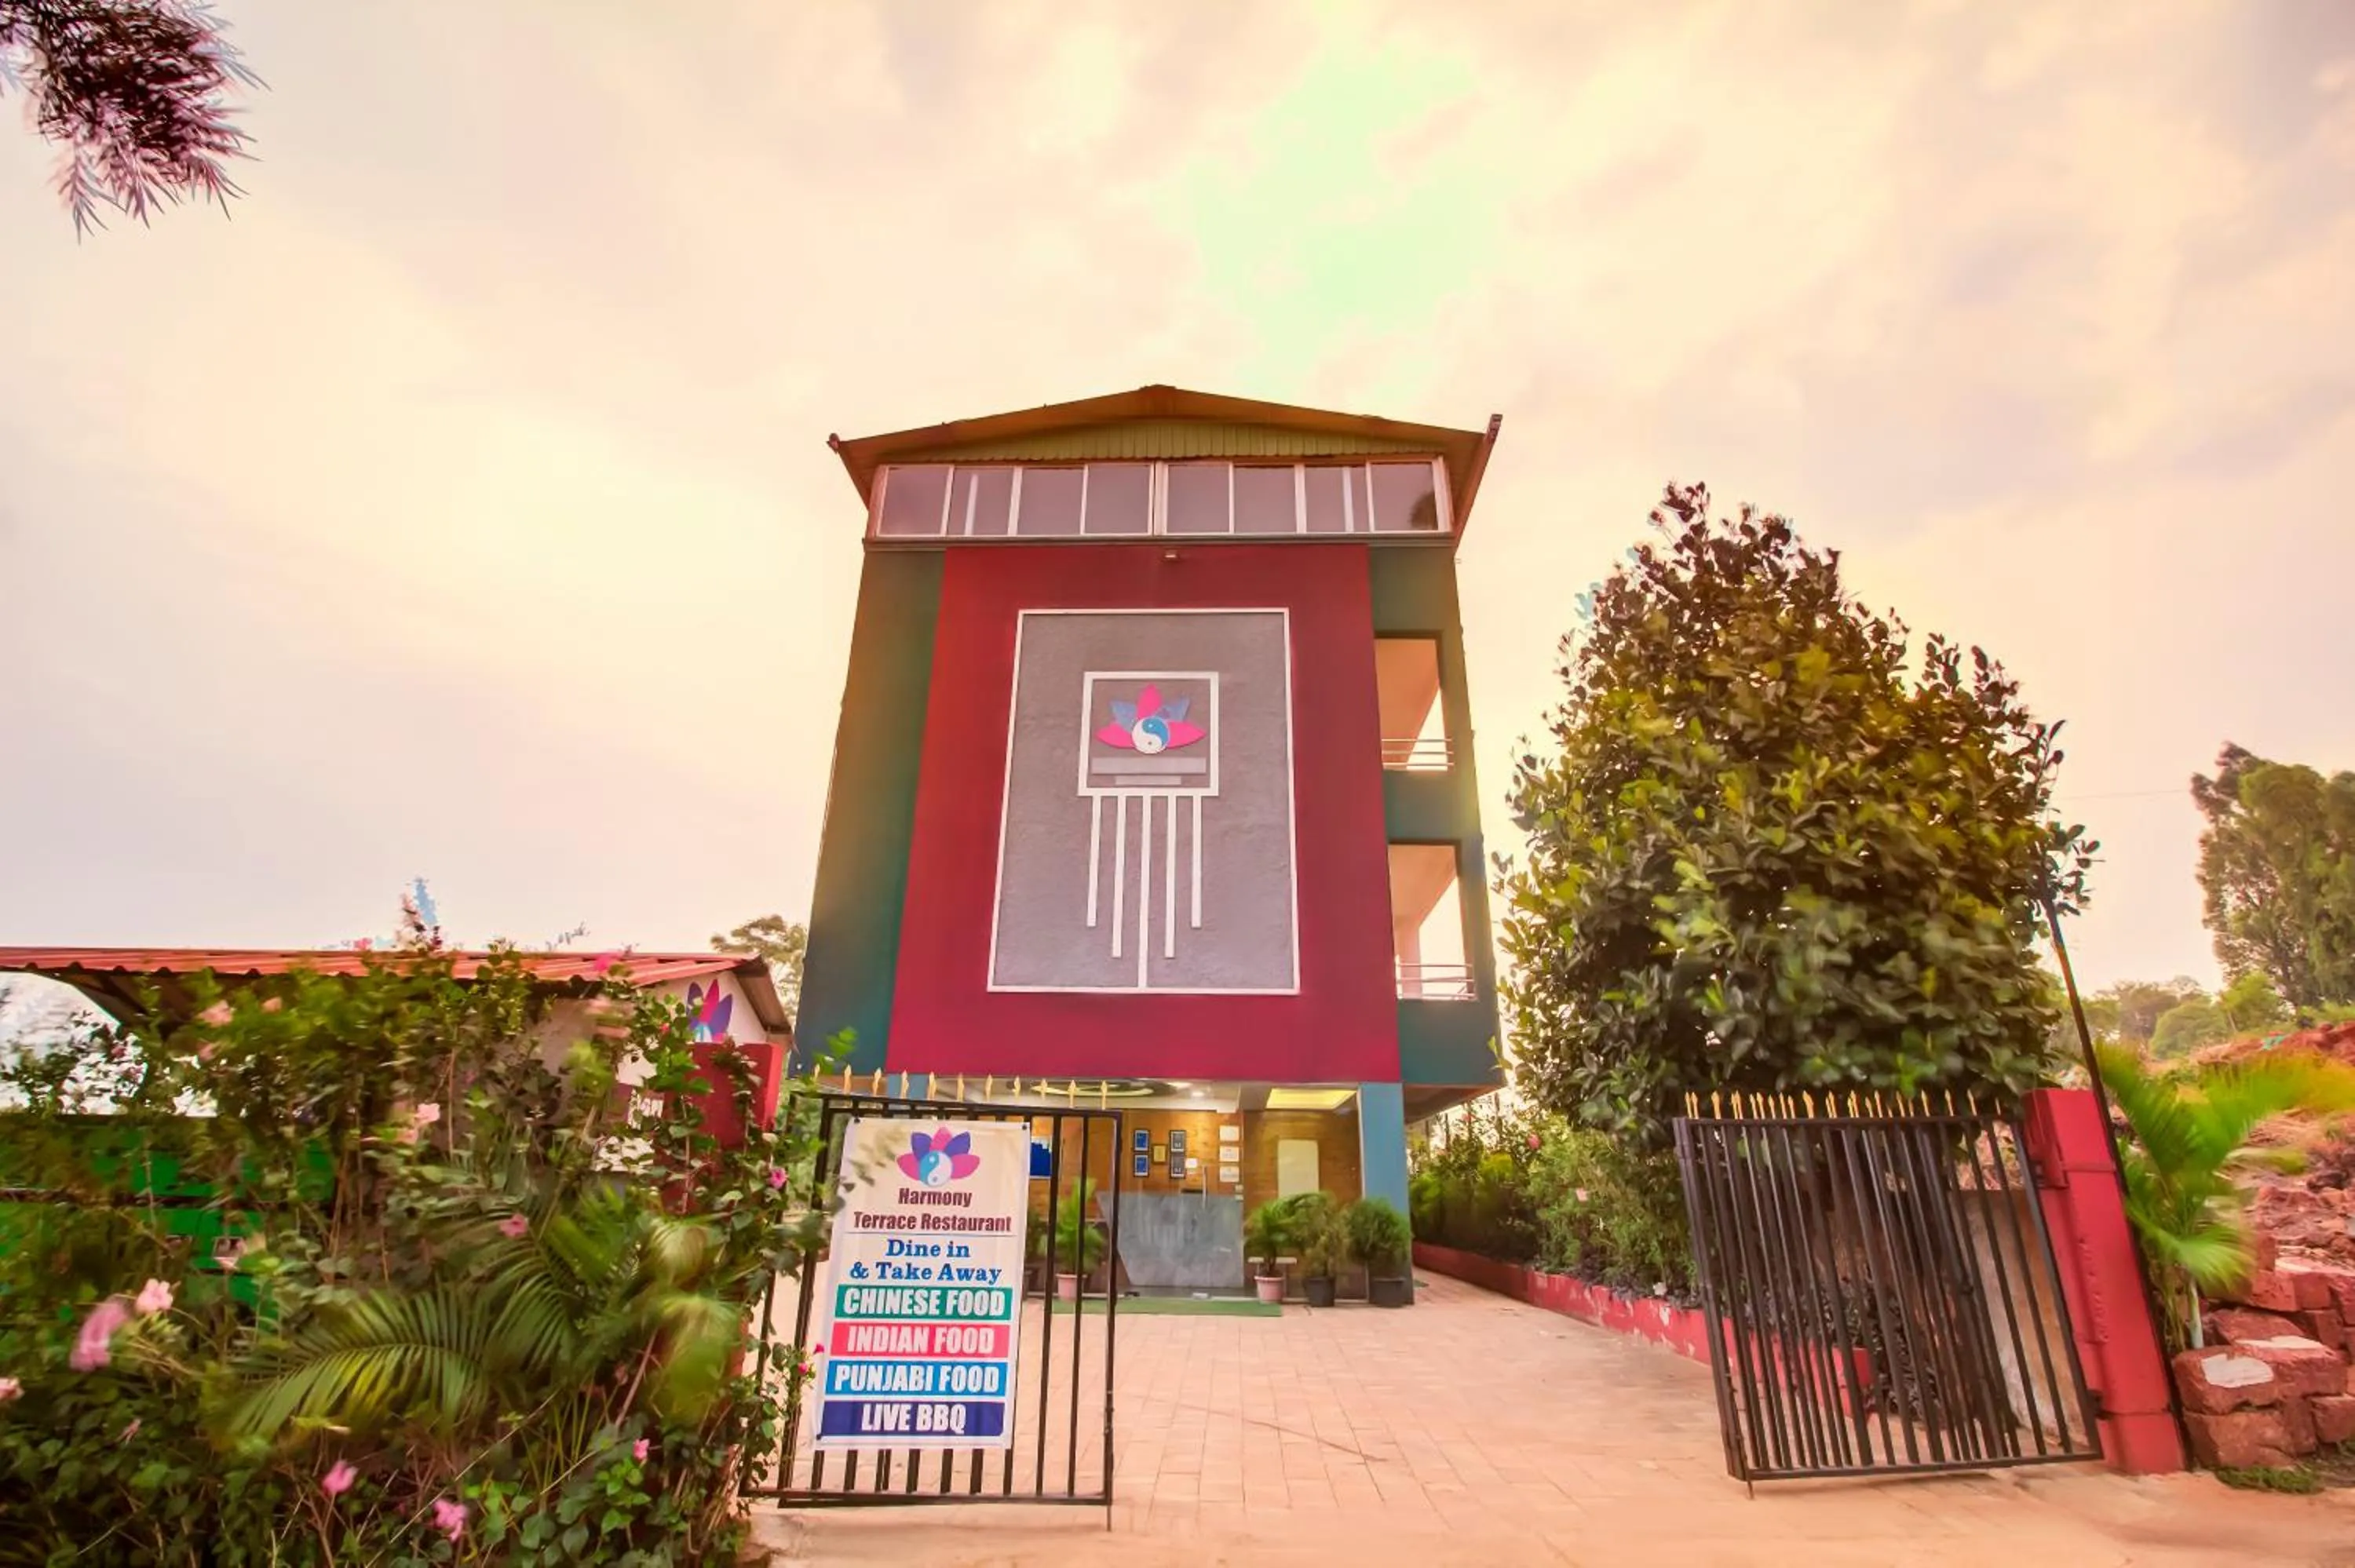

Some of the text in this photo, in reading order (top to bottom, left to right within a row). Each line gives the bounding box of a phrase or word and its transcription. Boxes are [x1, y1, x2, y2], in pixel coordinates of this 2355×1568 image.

[898, 1188, 973, 1207] Harmony
[854, 1212, 1011, 1231] Terrace Restaurant
[885, 1238, 971, 1257] Dine in
[849, 1261, 1002, 1285] & Take Away
[843, 1288, 1006, 1316] CHINESE FOOD
[847, 1326, 995, 1354] INDIAN FOOD
[834, 1365, 999, 1392] PUNJABI FOOD
[861, 1403, 966, 1435] LIVE BBQ
